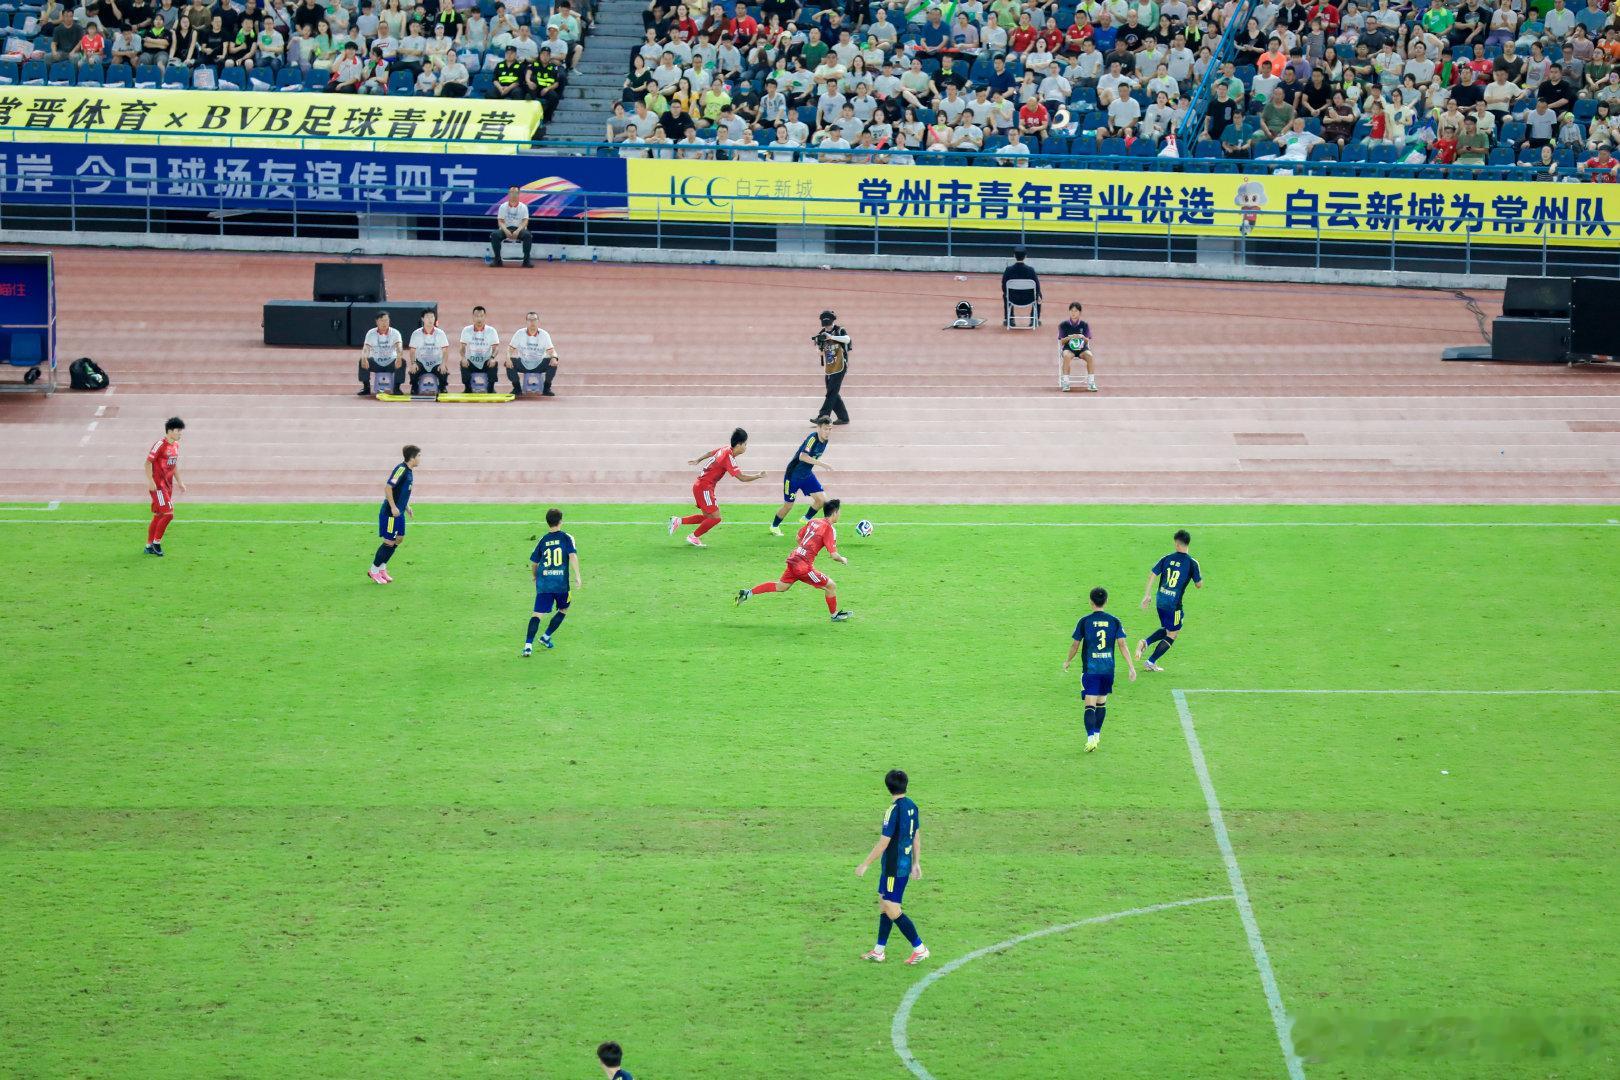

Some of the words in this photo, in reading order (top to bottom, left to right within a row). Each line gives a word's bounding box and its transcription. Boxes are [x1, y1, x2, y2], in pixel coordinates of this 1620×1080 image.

[0, 153, 53, 192] 岸
[76, 155, 478, 204] 今日球场友谊传四方
[670, 175, 730, 207] ICC
[736, 177, 814, 199] 白云新城
[857, 177, 1215, 225] 常州市青年置业优选
[1285, 189, 1612, 236] 白云新城为常州队
[543, 547, 563, 567] 30
[1166, 567, 1181, 588] 18
[1096, 629, 1107, 651] 3
